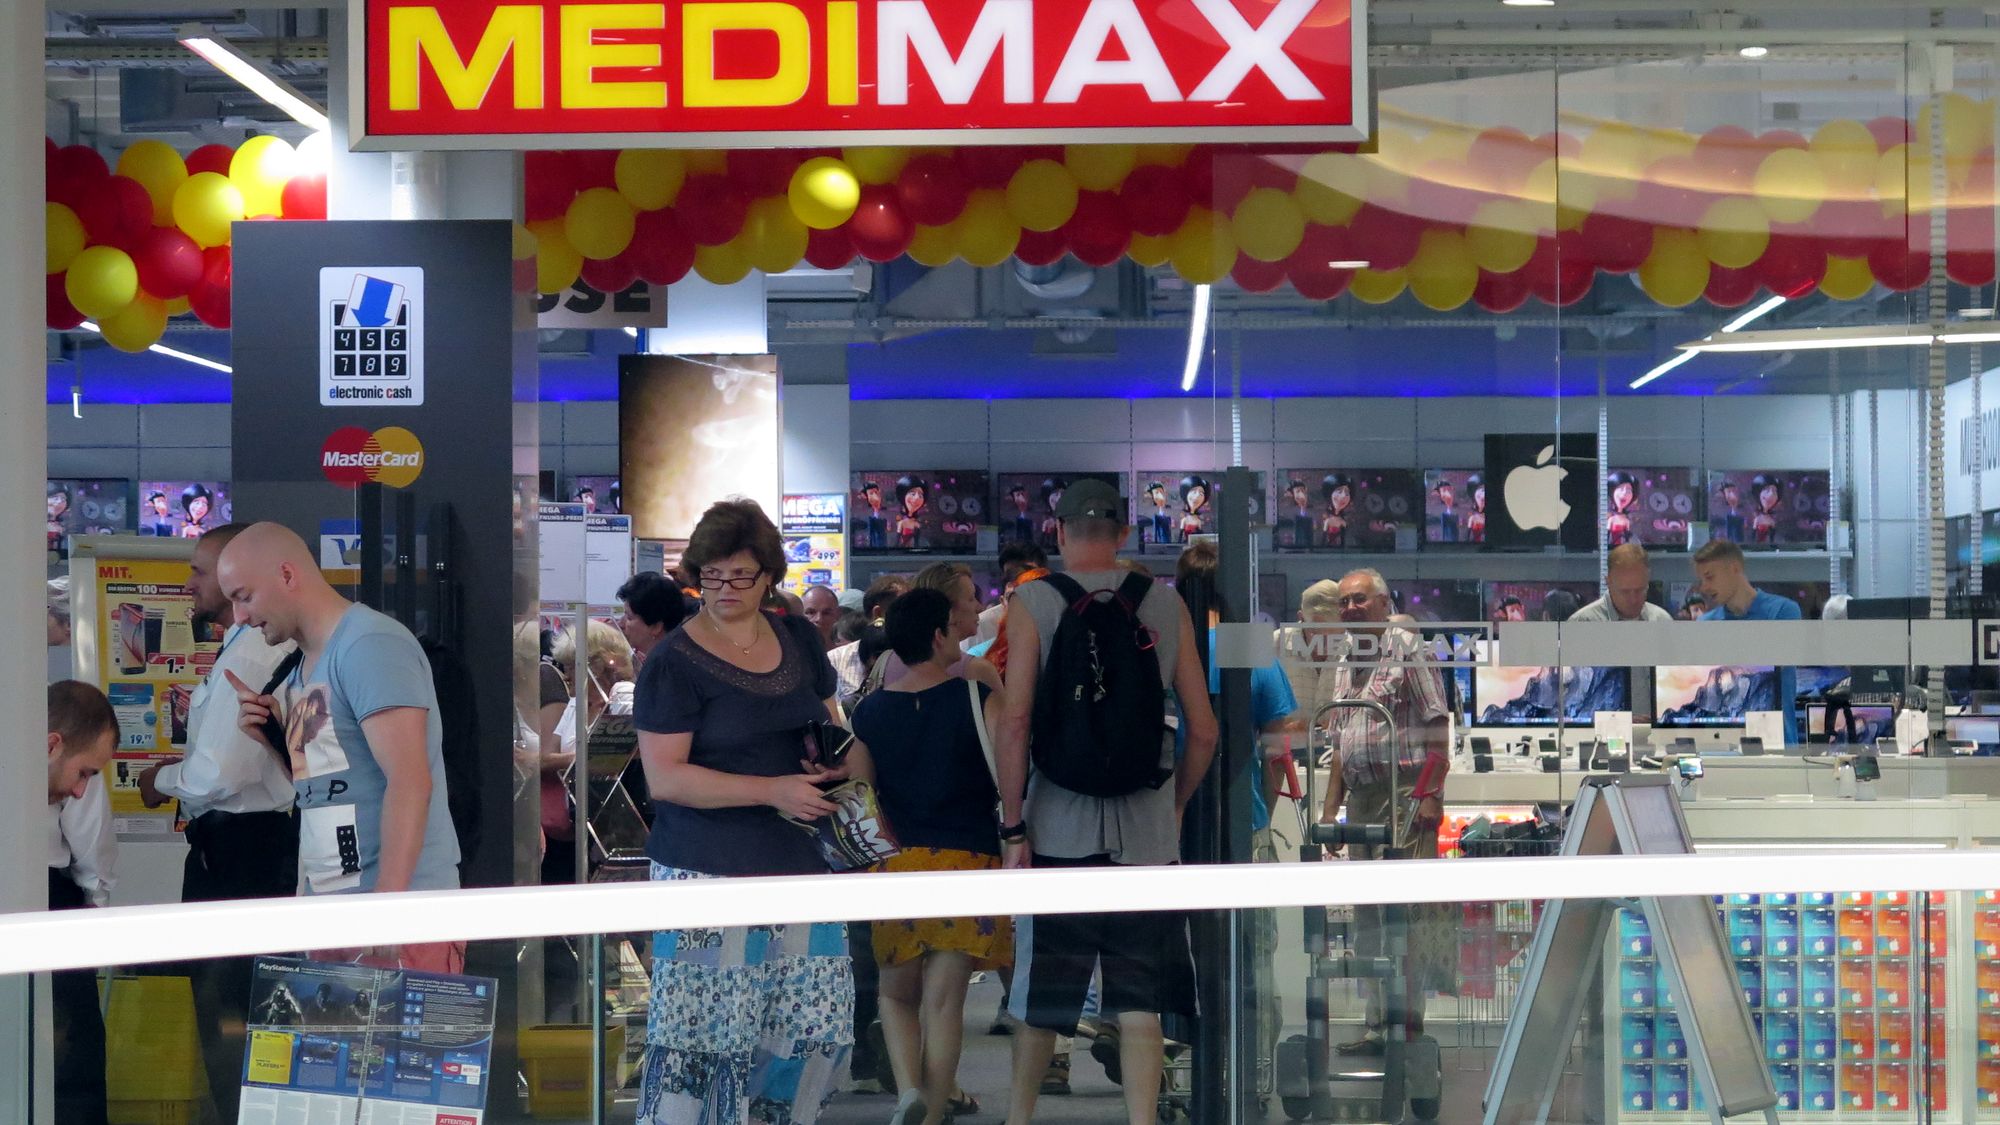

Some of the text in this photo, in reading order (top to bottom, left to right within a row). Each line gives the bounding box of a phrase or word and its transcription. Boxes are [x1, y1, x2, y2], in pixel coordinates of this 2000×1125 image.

[389, 0, 1323, 109] MEDIMAX
[341, 332, 400, 347] 4 5 6
[341, 358, 400, 372] 7 8 9
[329, 385, 412, 399] electronic cash
[323, 451, 420, 467] MasterCard
[99, 566, 132, 579] MIT.
[138, 585, 158, 594] 100
